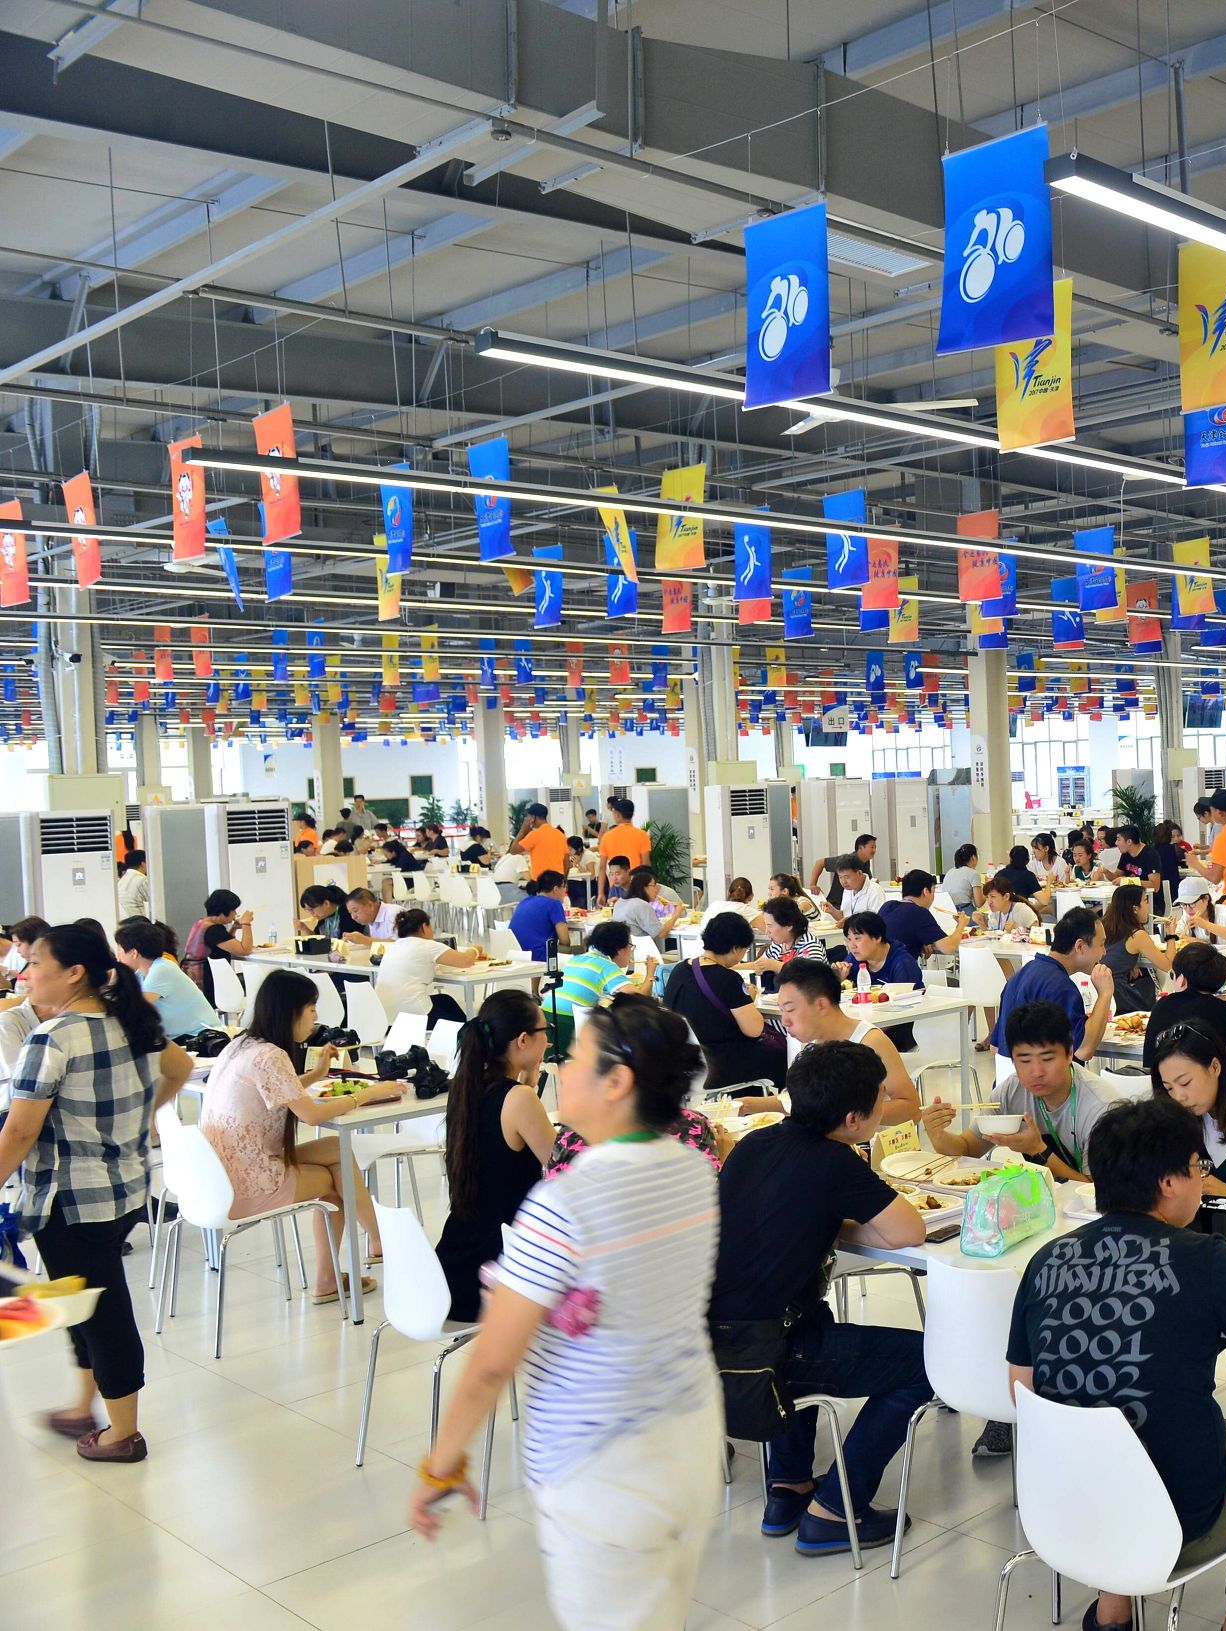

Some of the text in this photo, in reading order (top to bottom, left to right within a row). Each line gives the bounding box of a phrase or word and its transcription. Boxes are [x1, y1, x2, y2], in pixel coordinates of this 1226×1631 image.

[1033, 374, 1061, 388] Tianjin
[828, 717, 845, 725] 出口
[1044, 1234, 1174, 1266] BLACK
[1034, 1263, 1180, 1299] MAMBA
[1039, 1296, 1155, 1328] 2000
[1036, 1329, 1154, 1363] 2001
[1038, 1364, 1153, 1398] 2002
